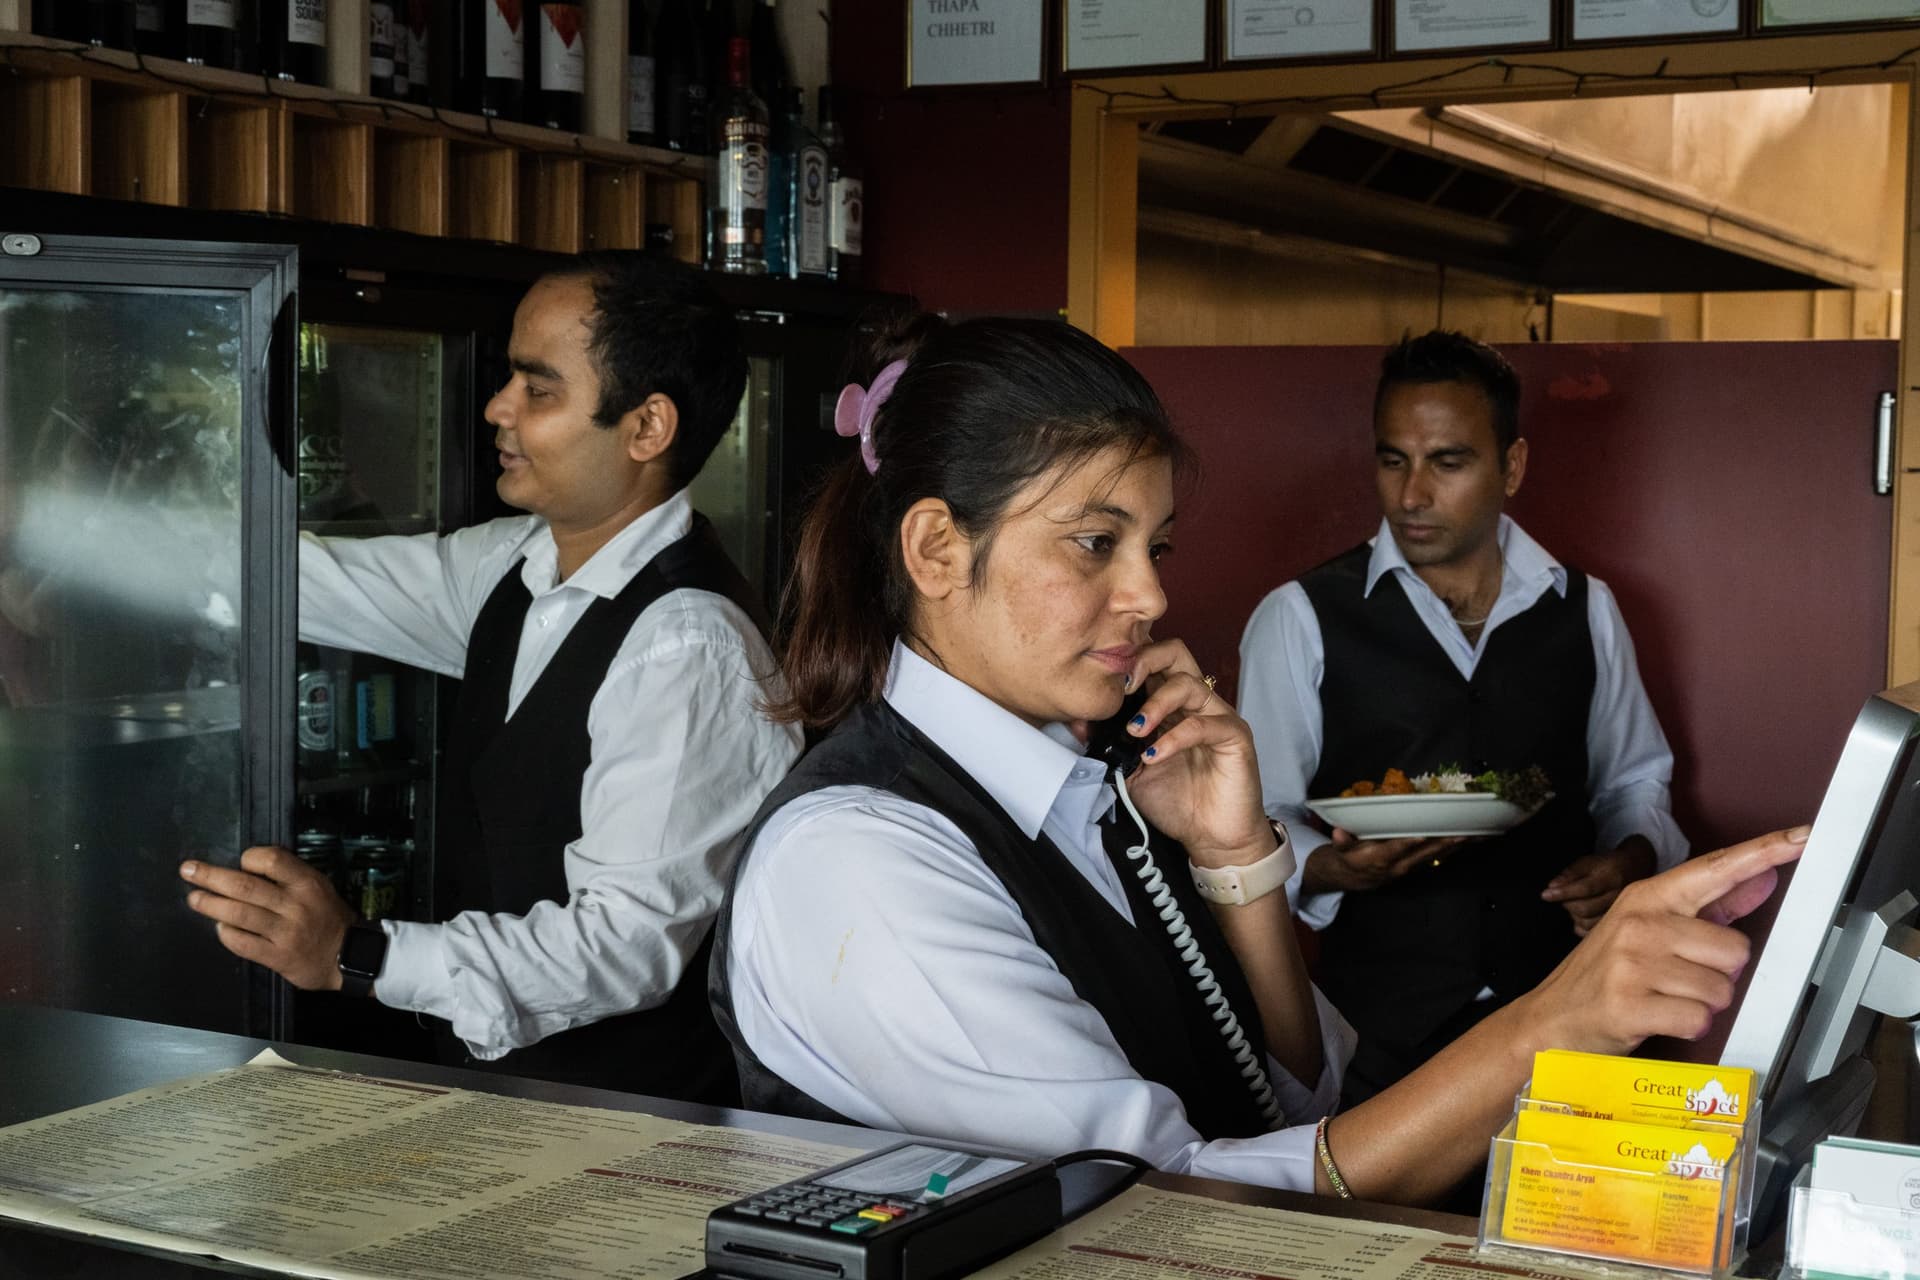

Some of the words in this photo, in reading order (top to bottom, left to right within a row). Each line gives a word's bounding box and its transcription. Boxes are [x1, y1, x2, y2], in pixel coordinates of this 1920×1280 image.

[928, 0, 980, 14] THAPA
[926, 21, 996, 38] CHHETRI
[1633, 1077, 1684, 1098] Great
[1616, 1140, 1669, 1162] Great
[1521, 1166, 1542, 1177] Khem
[1575, 1173, 1596, 1184] Aryal
